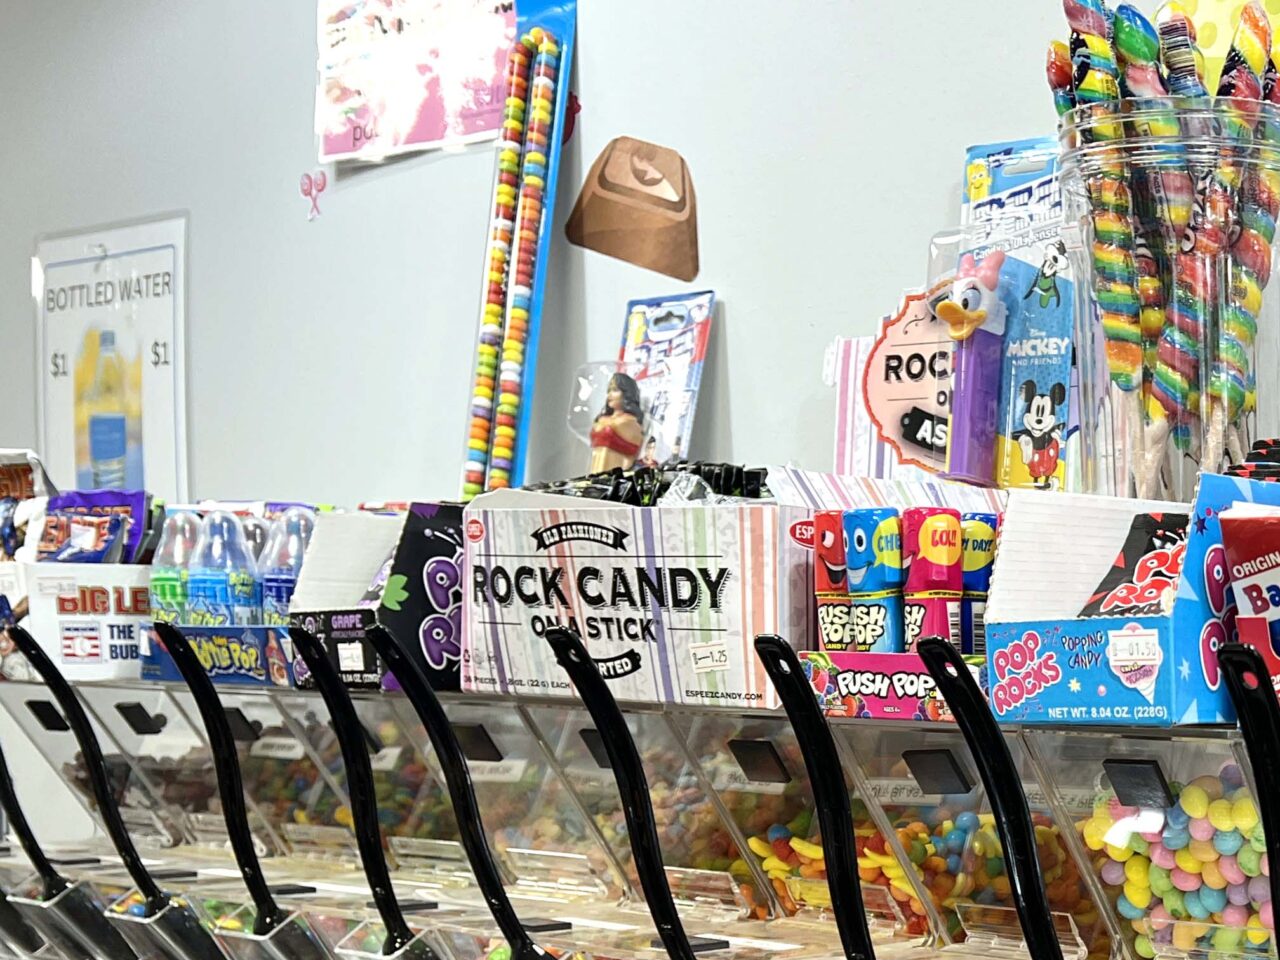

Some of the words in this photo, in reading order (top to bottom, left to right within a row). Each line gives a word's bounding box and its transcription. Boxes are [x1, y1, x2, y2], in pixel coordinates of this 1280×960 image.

[46, 281, 115, 312] BOTTLED
[118, 271, 172, 301] WATER
[150, 340, 170, 368] $1
[1006, 336, 1070, 358] MICKEY
[884, 350, 956, 384] ROC
[561, 525, 615, 543] FASHIONED
[795, 522, 815, 539] ESP
[877, 534, 900, 552] CHE
[473, 564, 573, 610] ROCK
[576, 565, 733, 613] CANDY
[57, 585, 110, 615] BIG
[331, 614, 363, 630] GRAPE
[818, 604, 850, 625] PUS
[107, 624, 135, 641] THE
[585, 616, 658, 643] STICK
[1061, 630, 1104, 652] POPPING
[109, 644, 139, 661] BUB
[994, 631, 1042, 680] POP
[1068, 650, 1103, 670] CANDY
[600, 657, 632, 678] RTED
[550, 680, 571, 689] EACH
[837, 670, 891, 698] PUSH
[891, 672, 937, 699] POP
[992, 651, 1063, 716] ROCKS
[685, 689, 763, 701] ESPEEZCANDY.COM
[1048, 706, 1069, 718] NET
[1071, 706, 1089, 718] WT.
[1091, 706, 1113, 718] 8.04
[1114, 706, 1132, 718] OZ.
[1134, 706, 1168, 720] (228G)
